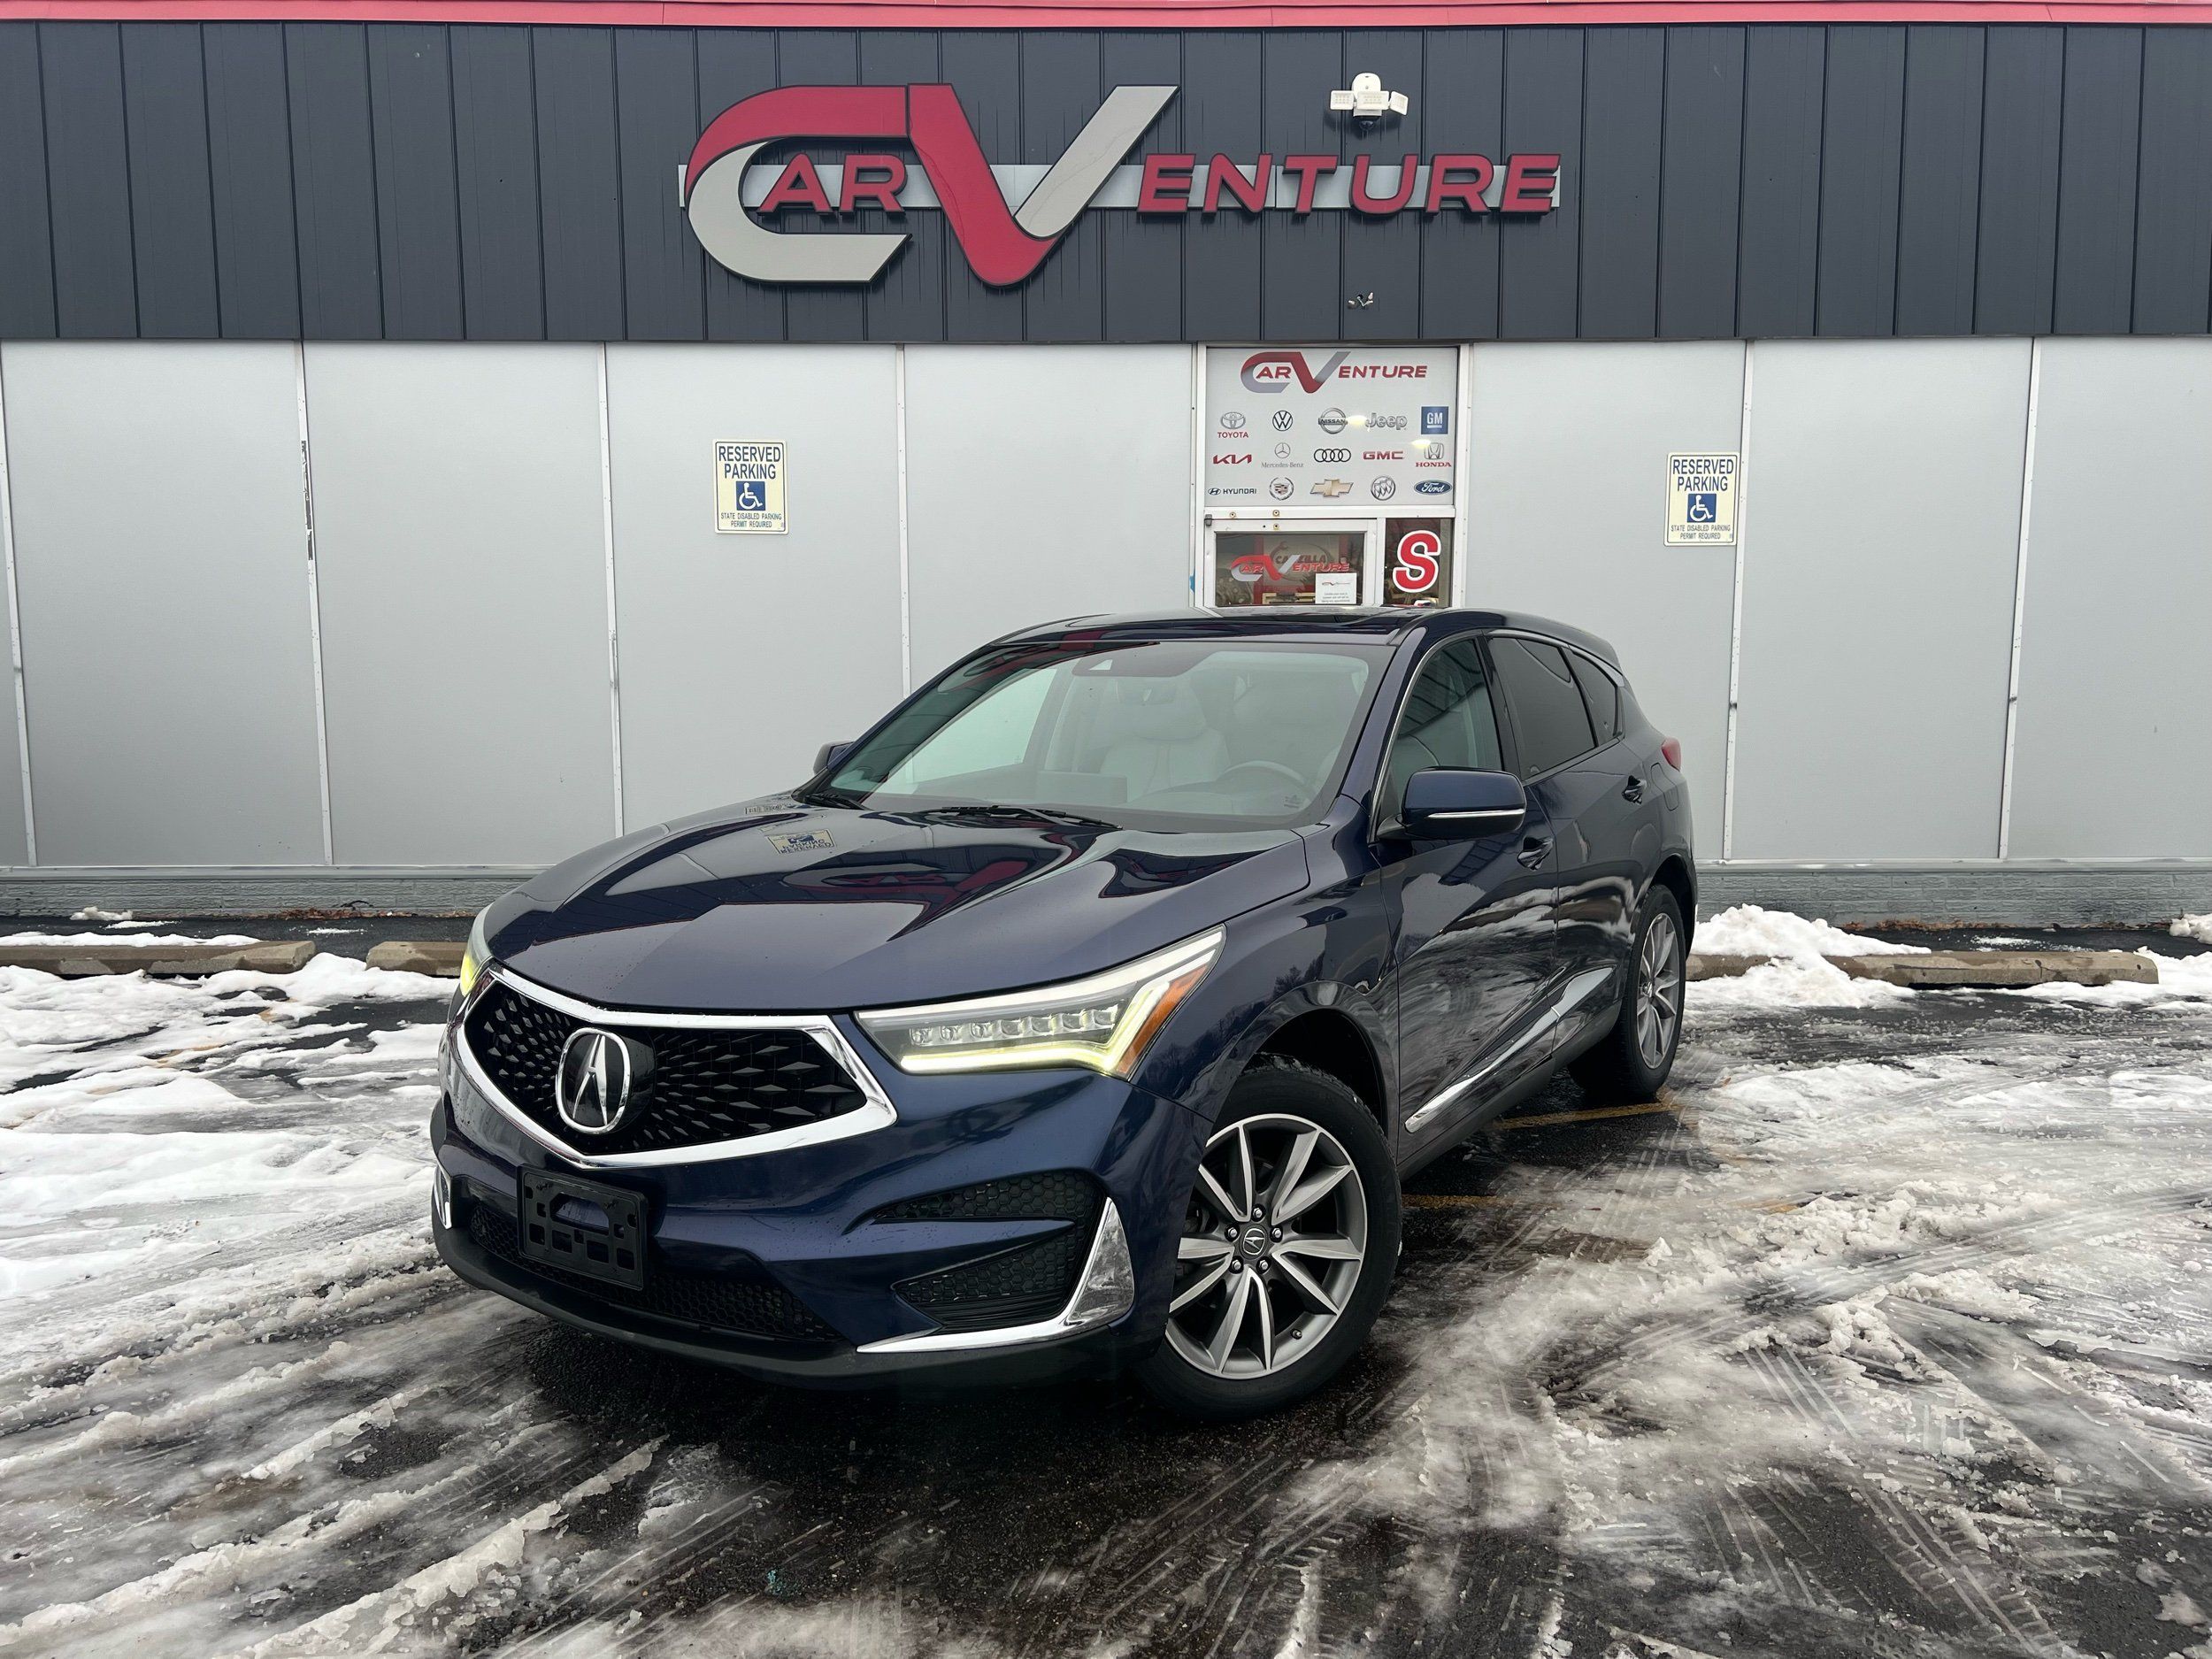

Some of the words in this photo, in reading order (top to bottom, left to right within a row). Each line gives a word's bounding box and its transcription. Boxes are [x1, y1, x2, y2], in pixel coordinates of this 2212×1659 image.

[1365, 412, 1408, 431] Jeep
[1426, 412, 1443, 425] GM
[718, 446, 781, 462] RESERVED
[1213, 454, 1252, 464] KIA
[1363, 450, 1404, 460] GMC
[725, 463, 776, 480] PARKING
[1672, 459, 1734, 475] RESERVED
[1421, 482, 1445, 493] Ford
[1678, 476, 1728, 491] PARKING
[1392, 530, 1442, 594] S
